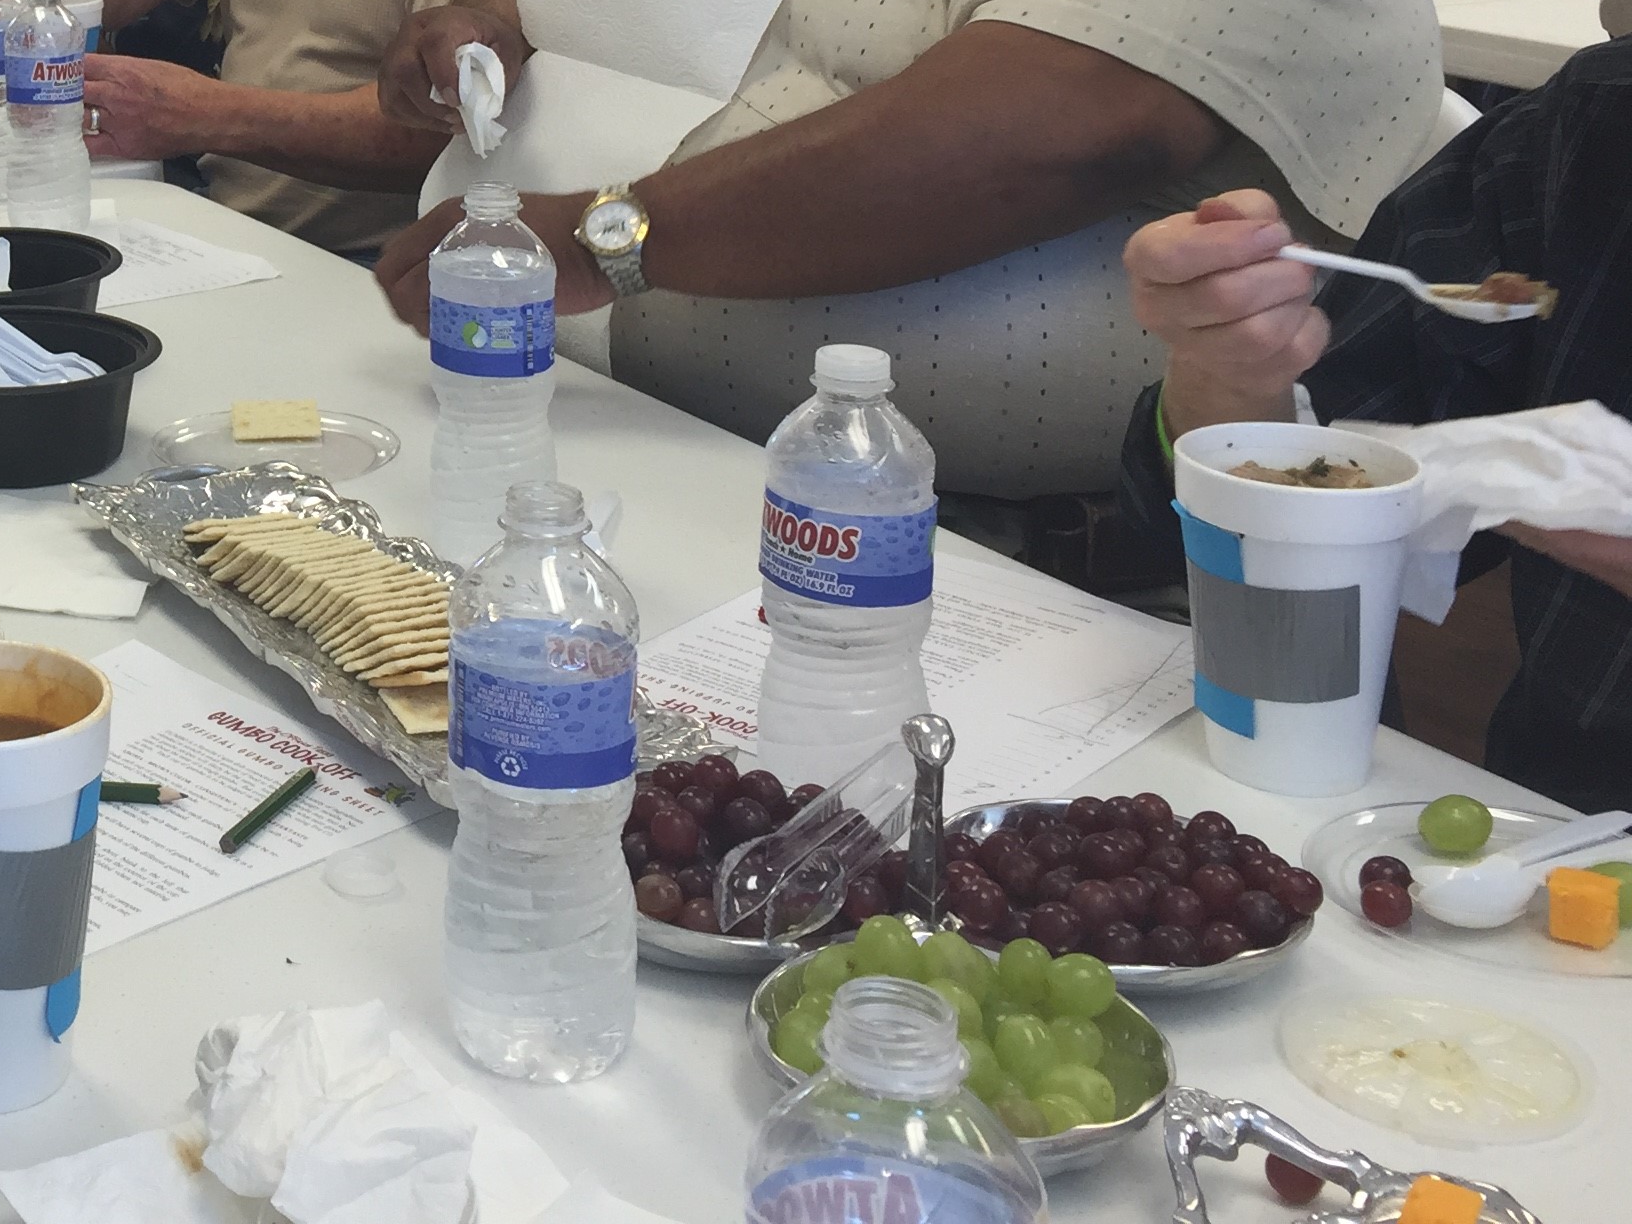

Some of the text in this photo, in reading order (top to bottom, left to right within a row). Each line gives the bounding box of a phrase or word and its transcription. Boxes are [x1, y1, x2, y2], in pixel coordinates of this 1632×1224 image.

[772, 555, 804, 575] DRINKING
[805, 569, 836, 582] WATER
[788, 547, 813, 564] Home
[806, 578, 824, 593] 16.9
[826, 582, 836, 594] FL
[839, 584, 854, 597] OZ
[669, 683, 731, 706] JUDGING
[207, 711, 276, 743] GUMBO
[656, 698, 759, 734] COOK-OFF
[181, 722, 234, 749] OFFICIAL
[237, 748, 284, 771] GUMBO
[342, 795, 386, 817] SHEET
